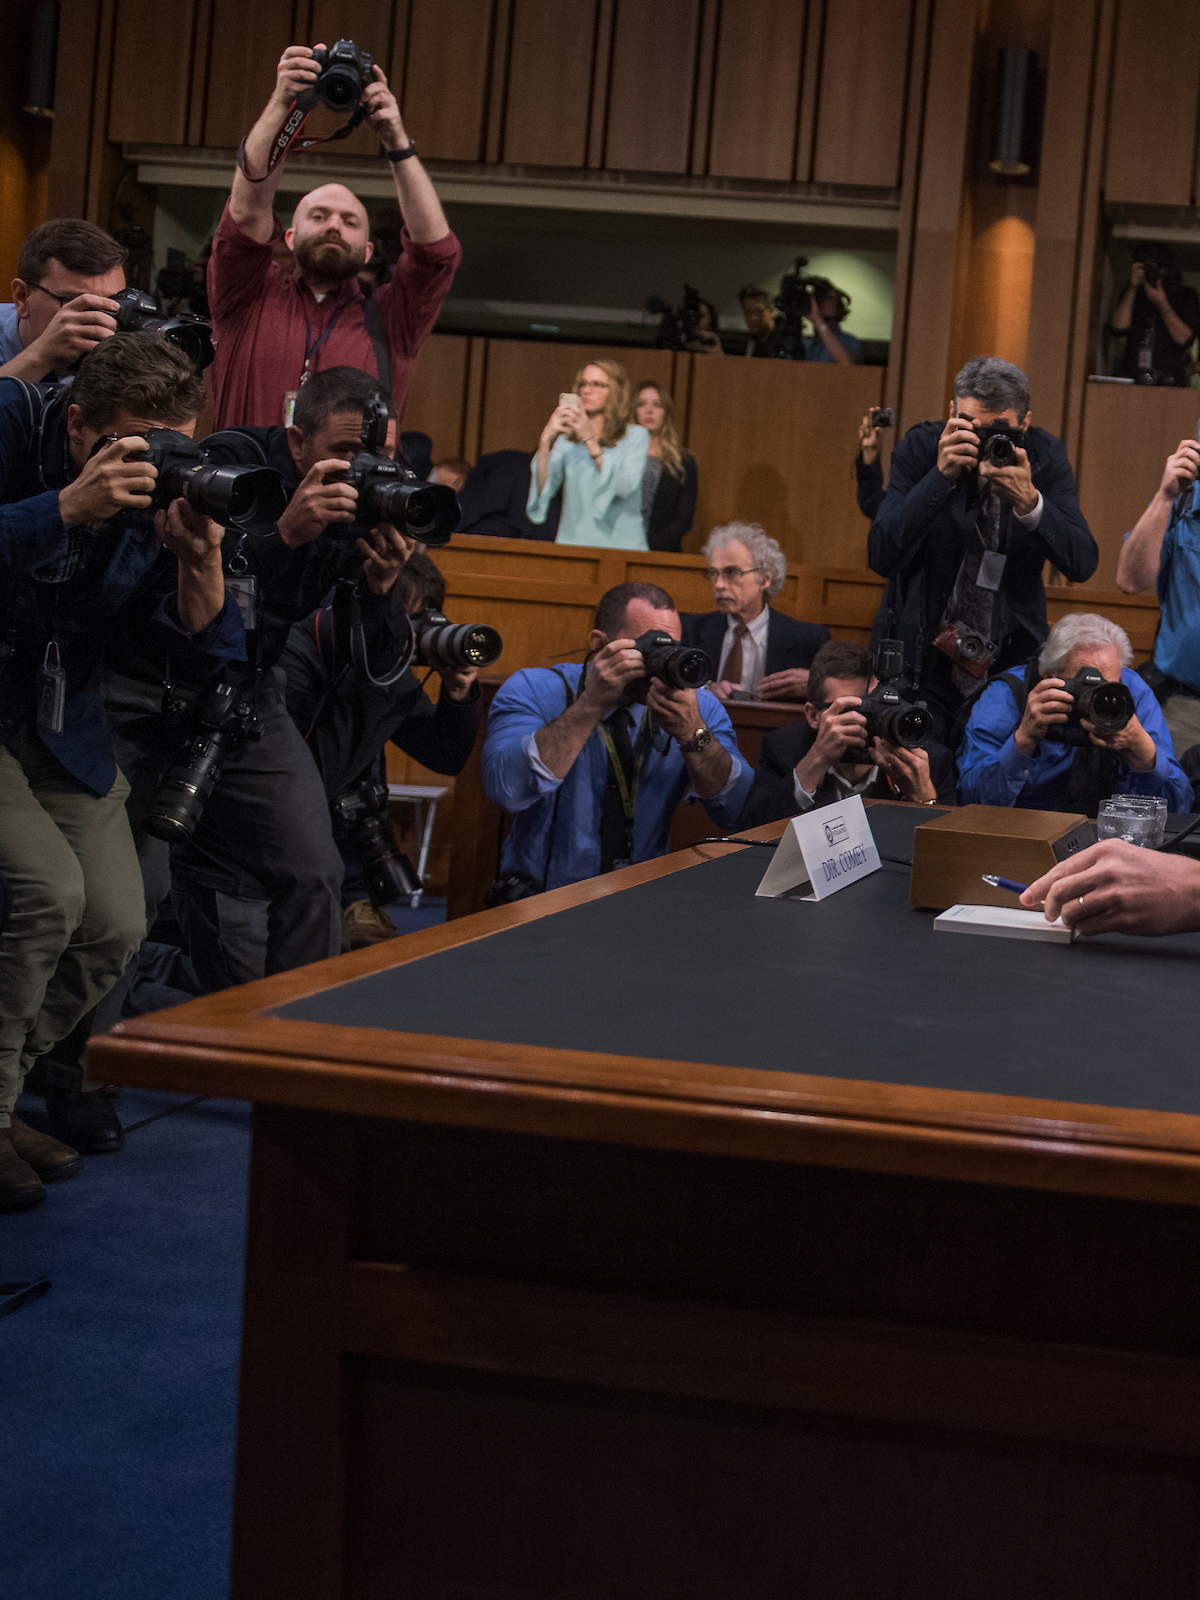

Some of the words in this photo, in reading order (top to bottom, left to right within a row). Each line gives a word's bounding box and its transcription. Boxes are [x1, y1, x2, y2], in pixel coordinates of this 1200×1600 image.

[284, 109, 304, 135] EOS
[277, 132, 290, 148] 5D
[377, 464, 396, 472] Nikon
[839, 844, 867, 873] COMEY
